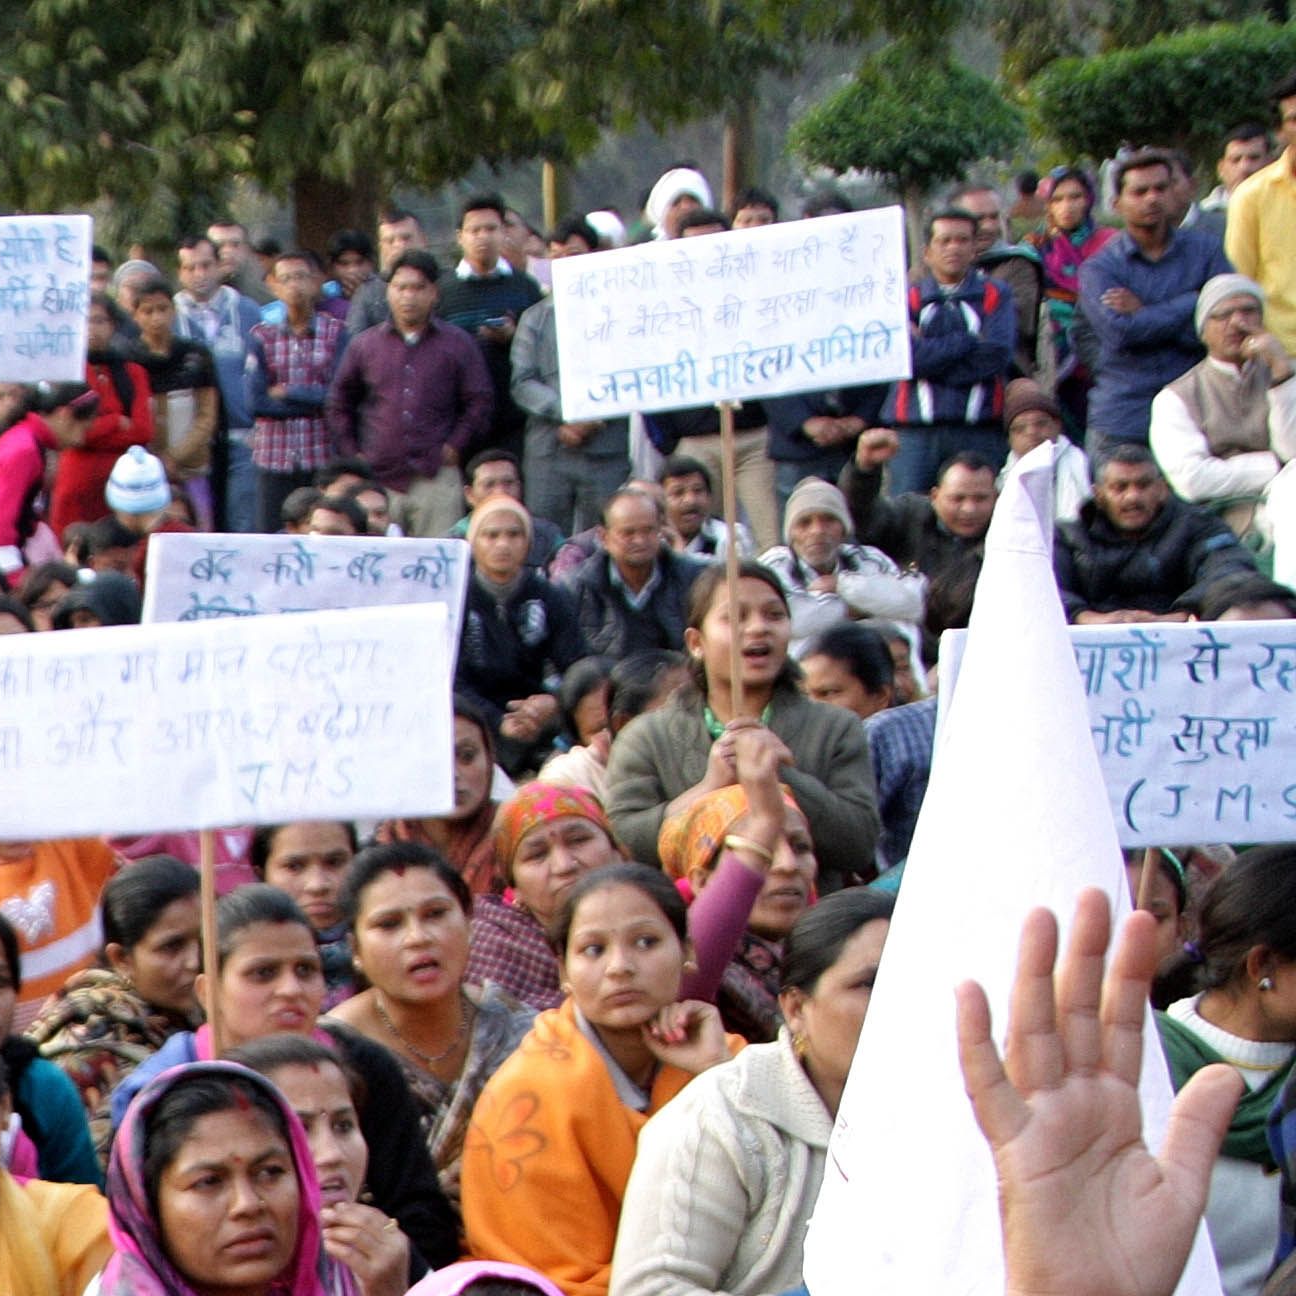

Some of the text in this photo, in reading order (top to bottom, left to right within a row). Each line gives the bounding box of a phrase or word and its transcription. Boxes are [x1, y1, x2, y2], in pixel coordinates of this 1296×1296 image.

[588, 320, 901, 402] जनवादी महिला समिति
[262, 541, 317, 586] करो
[400, 545, 457, 589] करो
[1184, 628, 1231, 683] से
[1171, 714, 1278, 767] सुरक्षा
